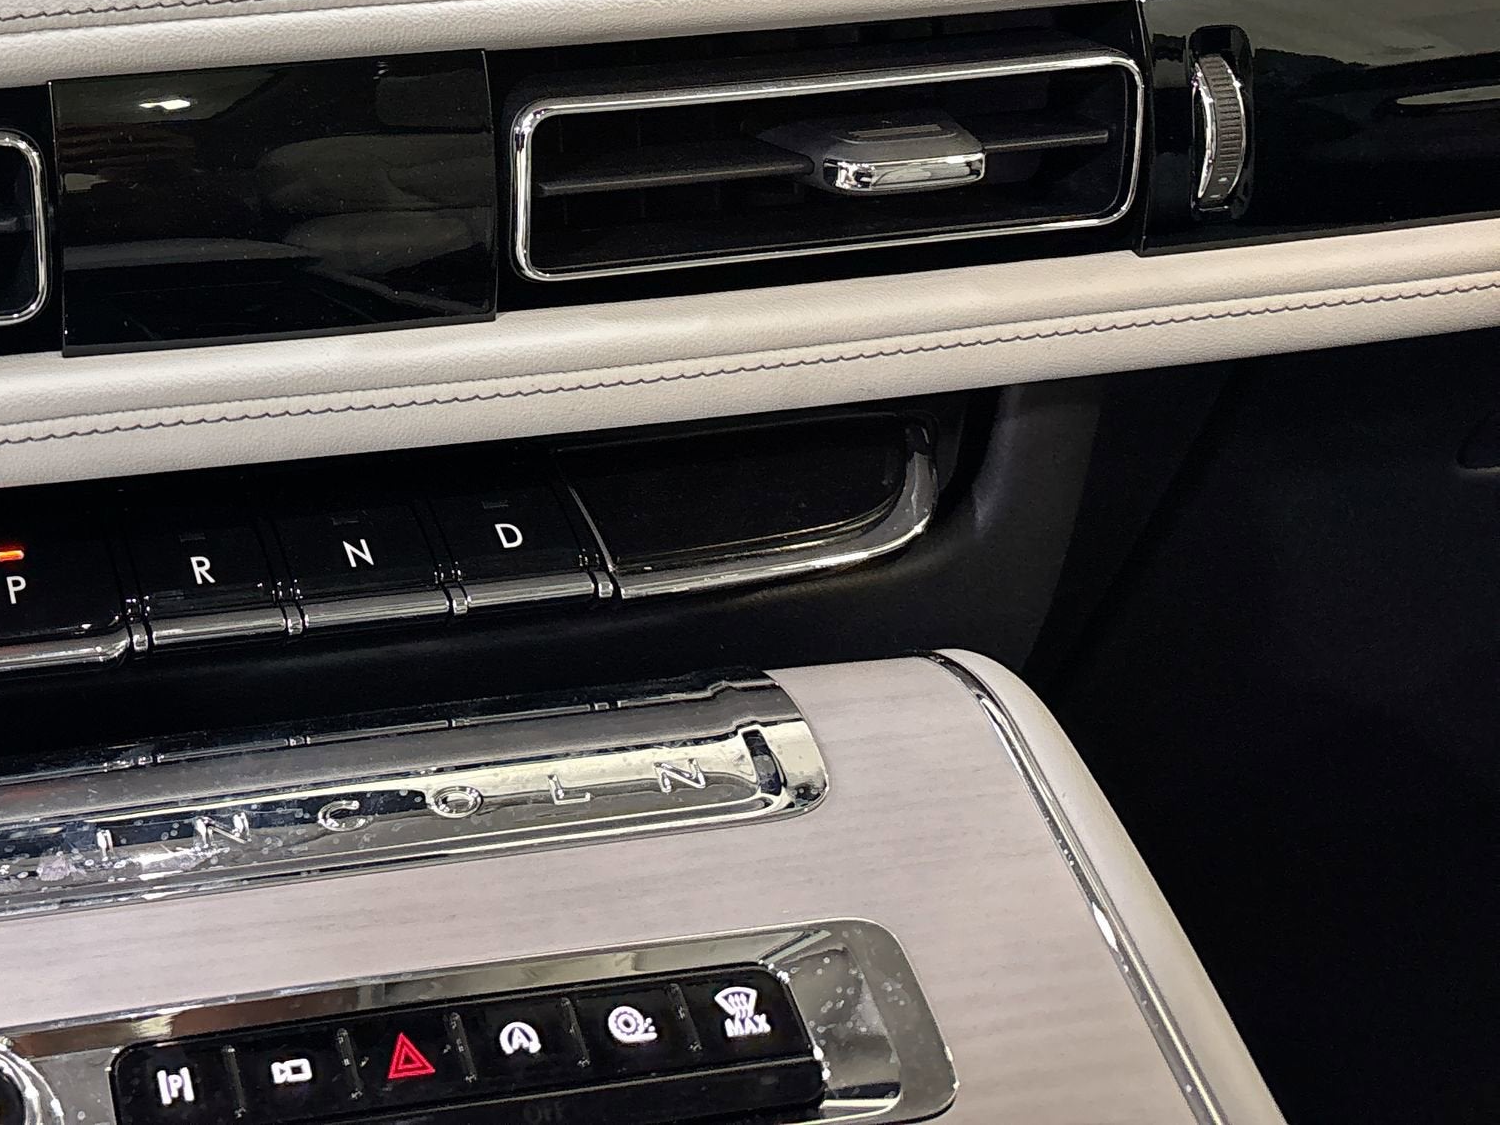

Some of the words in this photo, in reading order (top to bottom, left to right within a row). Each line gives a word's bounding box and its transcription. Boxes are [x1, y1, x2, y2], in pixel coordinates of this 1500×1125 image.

[494, 523, 523, 549] D
[342, 538, 374, 568] N
[190, 556, 216, 585] R
[6, 575, 27, 605] P
[724, 1013, 772, 1038] MAX
